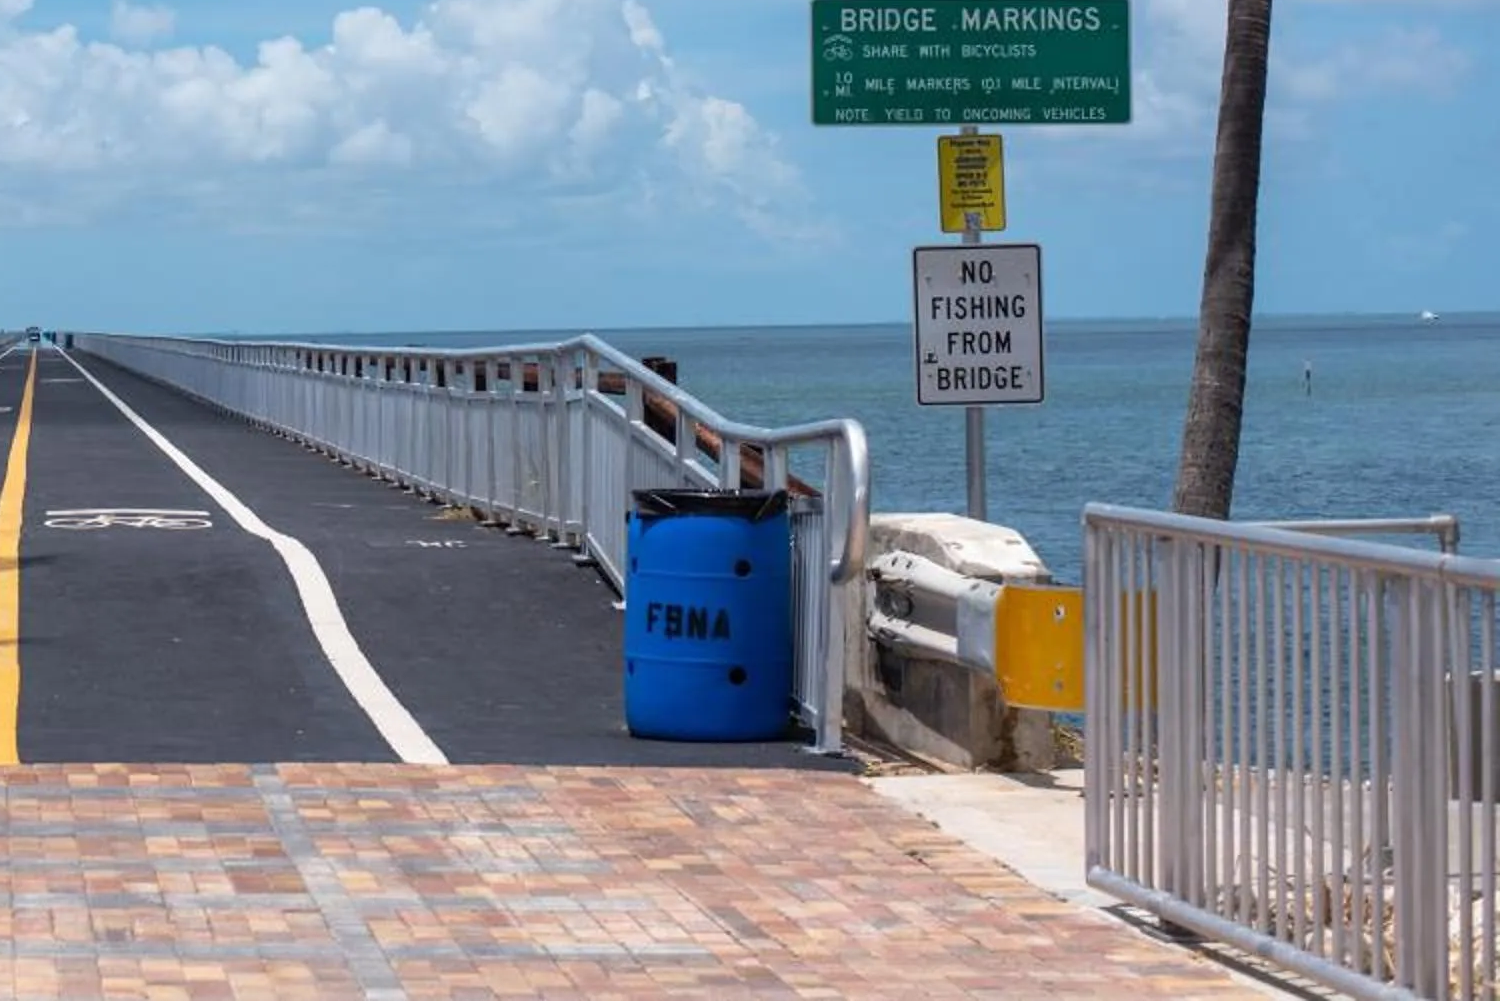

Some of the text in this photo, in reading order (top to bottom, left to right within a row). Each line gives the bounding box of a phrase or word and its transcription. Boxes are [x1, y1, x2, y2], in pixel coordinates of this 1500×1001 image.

[840, 7, 1101, 32] BRIDGE MARKINGS
[862, 44, 1037, 58] SHARE WITH BICYCLISTS
[865, 78, 896, 91] MILE
[906, 78, 972, 91] MARKERS
[1011, 77, 1042, 90] MILE
[885, 108, 923, 121] YIELD
[934, 108, 951, 121] TO
[963, 107, 1031, 120] ONCOMING
[1043, 106, 1106, 120] VEHICLES
[961, 260, 993, 284] NO
[931, 295, 1025, 319] FISHING
[947, 331, 1012, 354] FROM
[937, 366, 1023, 390] BRIDGE
[647, 603, 730, 640] FBNA
